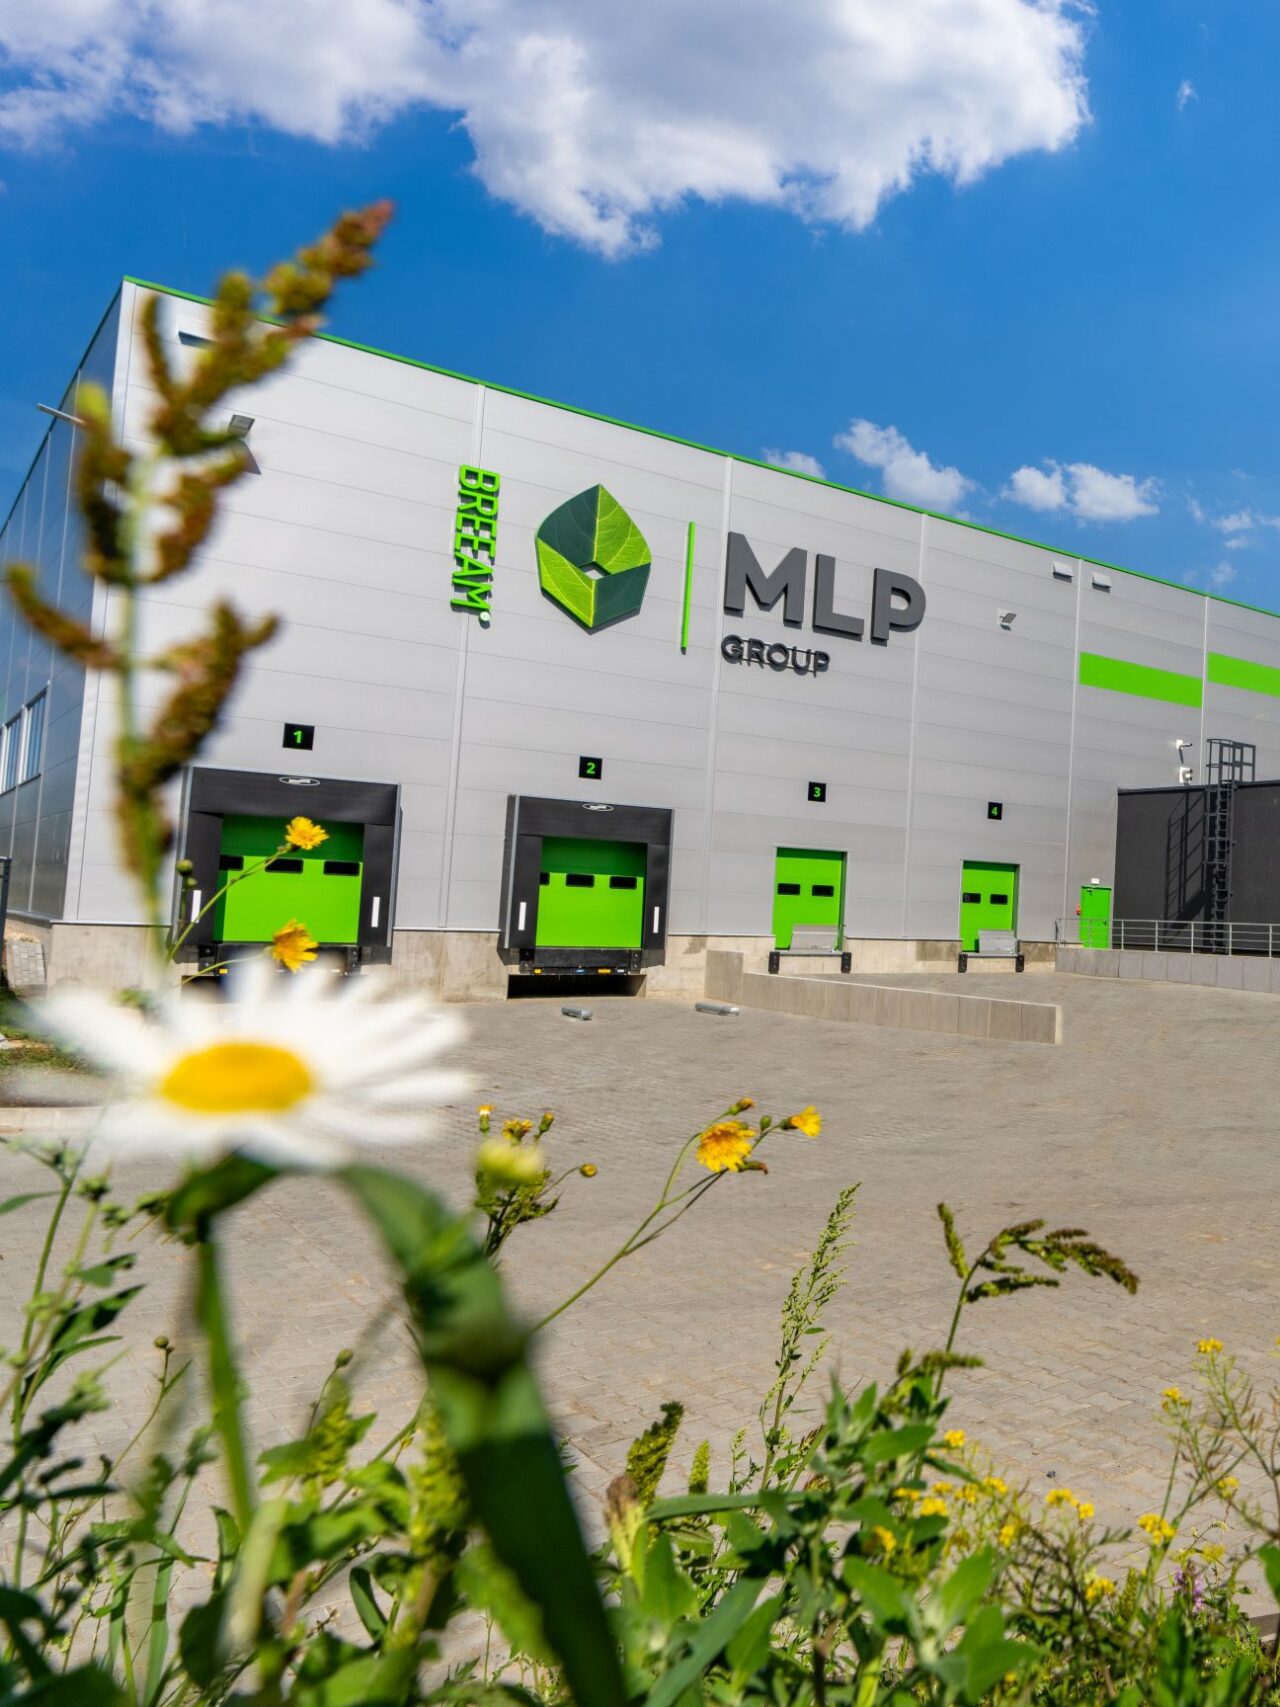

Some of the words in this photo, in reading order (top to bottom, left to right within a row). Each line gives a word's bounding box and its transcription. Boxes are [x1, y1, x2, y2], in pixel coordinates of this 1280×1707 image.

[450, 464, 500, 610] BREEAM
[724, 531, 926, 640] MLP
[721, 635, 830, 674] GROUP
[293, 730, 302, 744] 1
[586, 762, 596, 774] 2
[813, 786, 821, 798] 3
[991, 806, 998, 816] 4
